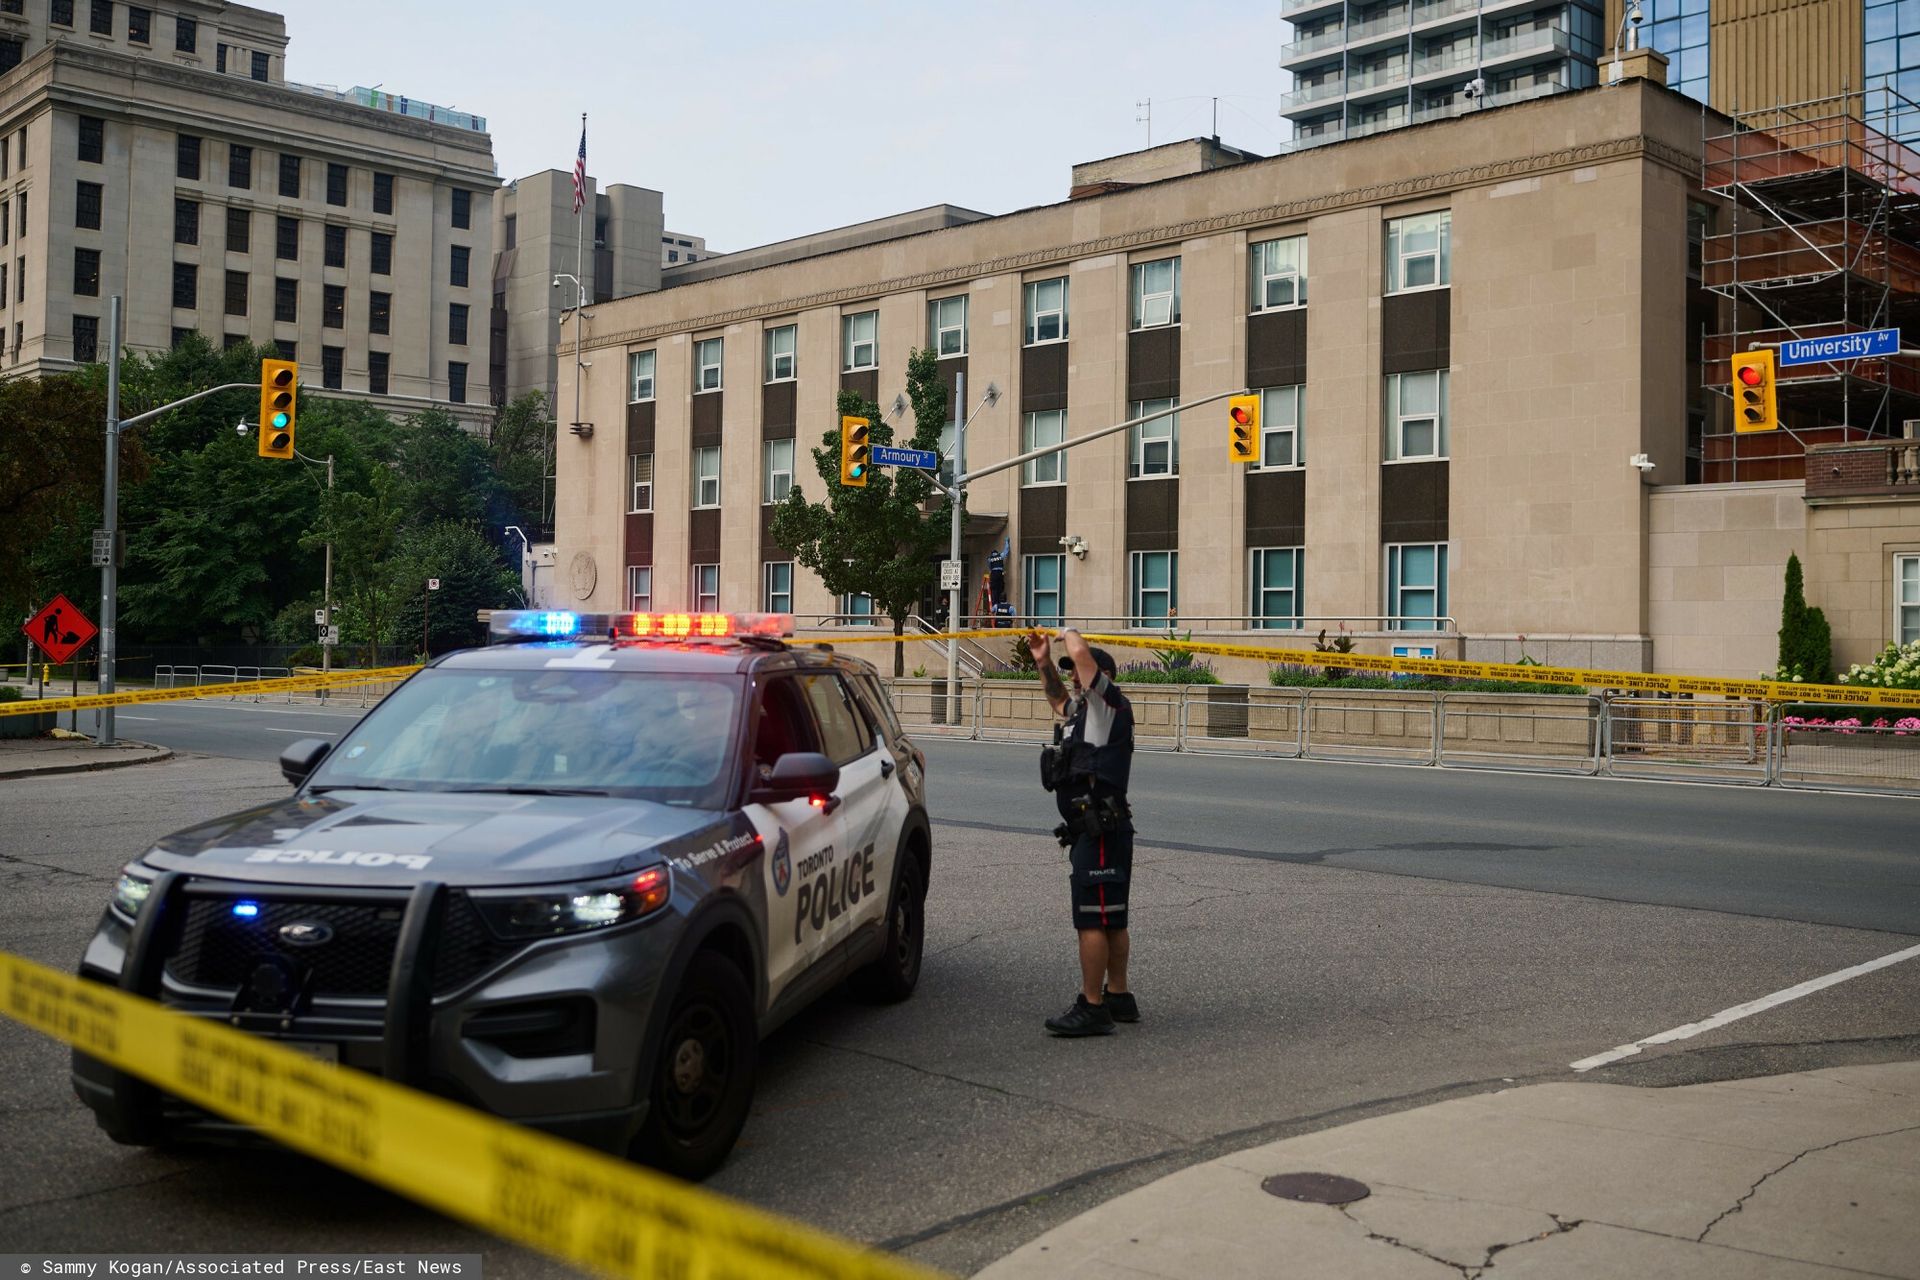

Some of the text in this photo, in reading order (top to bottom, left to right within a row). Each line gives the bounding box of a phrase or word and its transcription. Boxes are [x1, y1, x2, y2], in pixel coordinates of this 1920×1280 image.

[1789, 332, 1889, 359] University Av
[880, 448, 921, 466] Armoury
[673, 857, 692, 871] To
[687, 848, 718, 866] Serve
[797, 844, 833, 880] TORONTO
[1088, 868, 1116, 877] POLICE
[795, 842, 875, 945] POLICE
